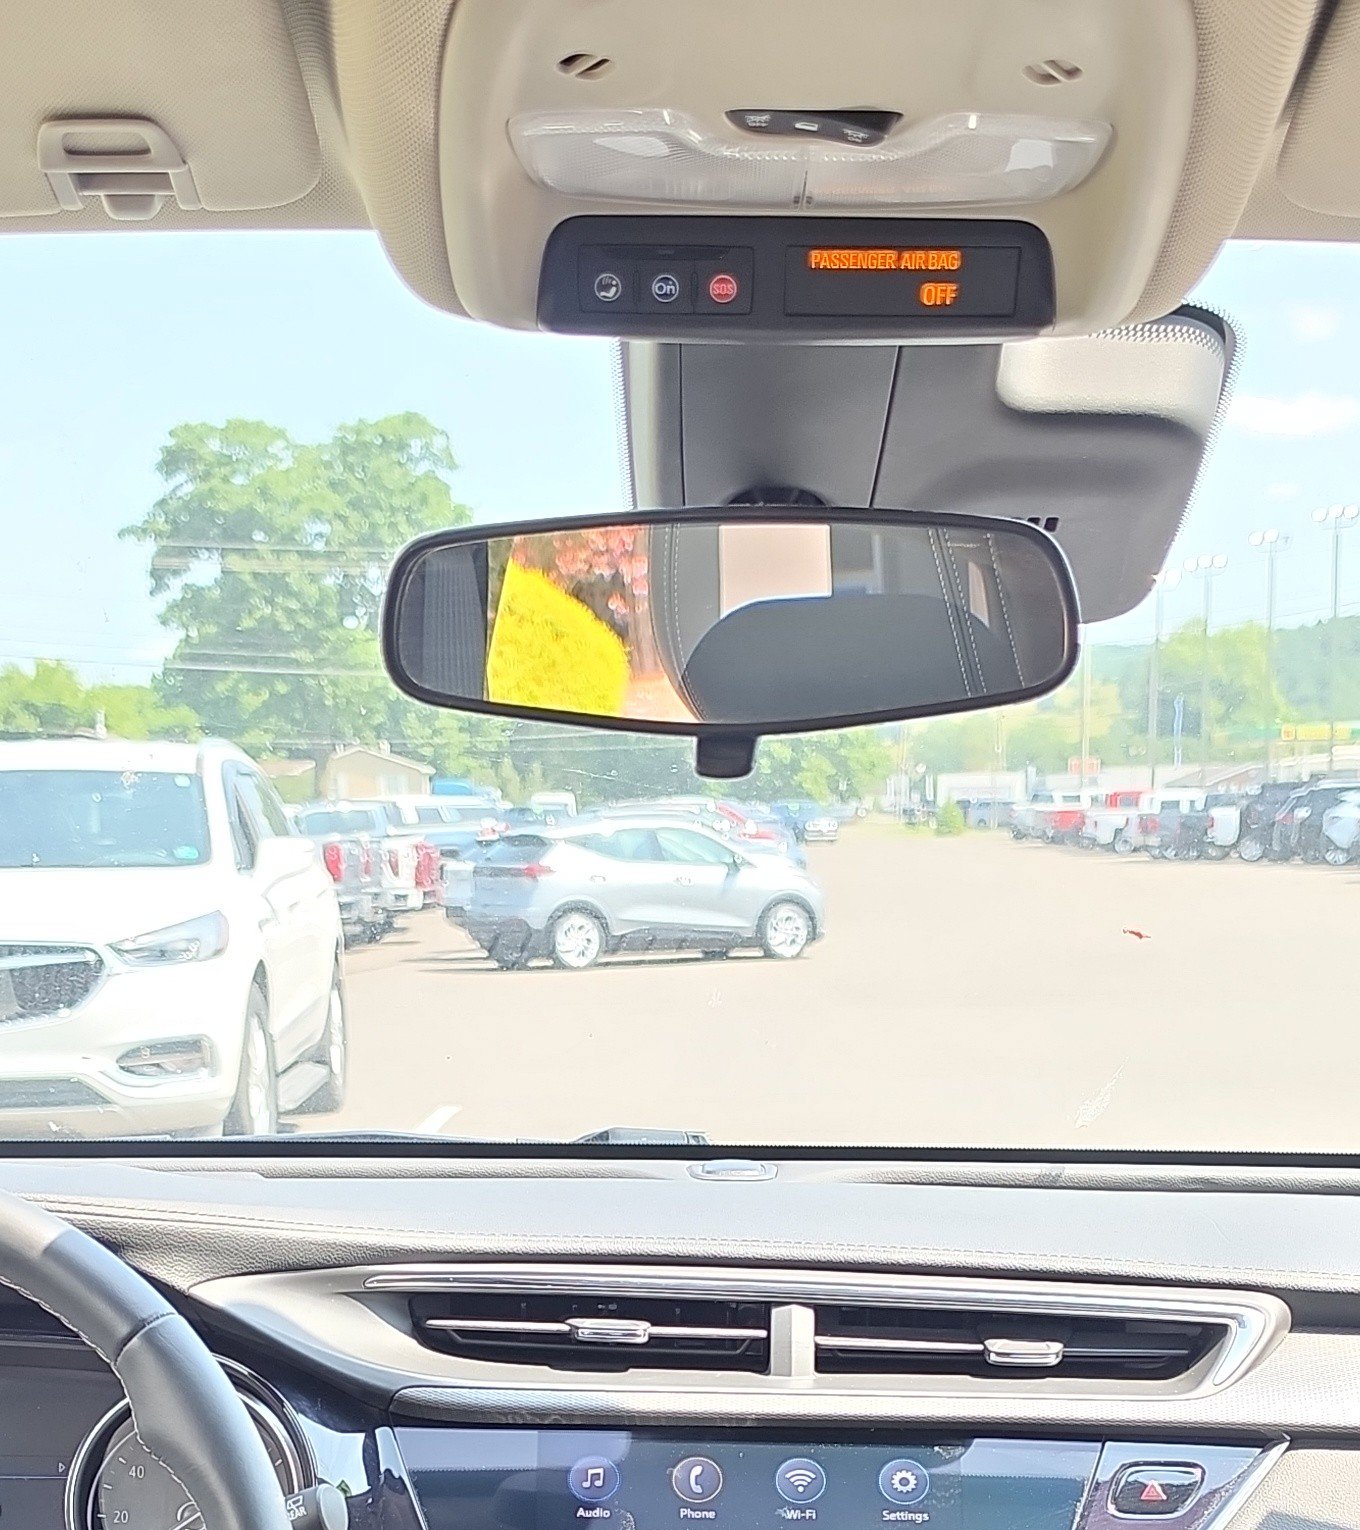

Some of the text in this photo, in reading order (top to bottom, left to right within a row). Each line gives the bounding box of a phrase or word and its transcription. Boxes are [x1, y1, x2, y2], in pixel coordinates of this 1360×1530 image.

[810, 250, 897, 270] PASSENGER
[712, 282, 734, 296] SOS
[921, 283, 958, 306] OFF
[128, 1465, 145, 1479] 40
[113, 1510, 129, 1524] 20
[576, 1507, 611, 1518] Audio
[679, 1508, 717, 1519] Phone
[785, 1509, 817, 1520] Wi-Fi
[882, 1510, 930, 1523] Settings
